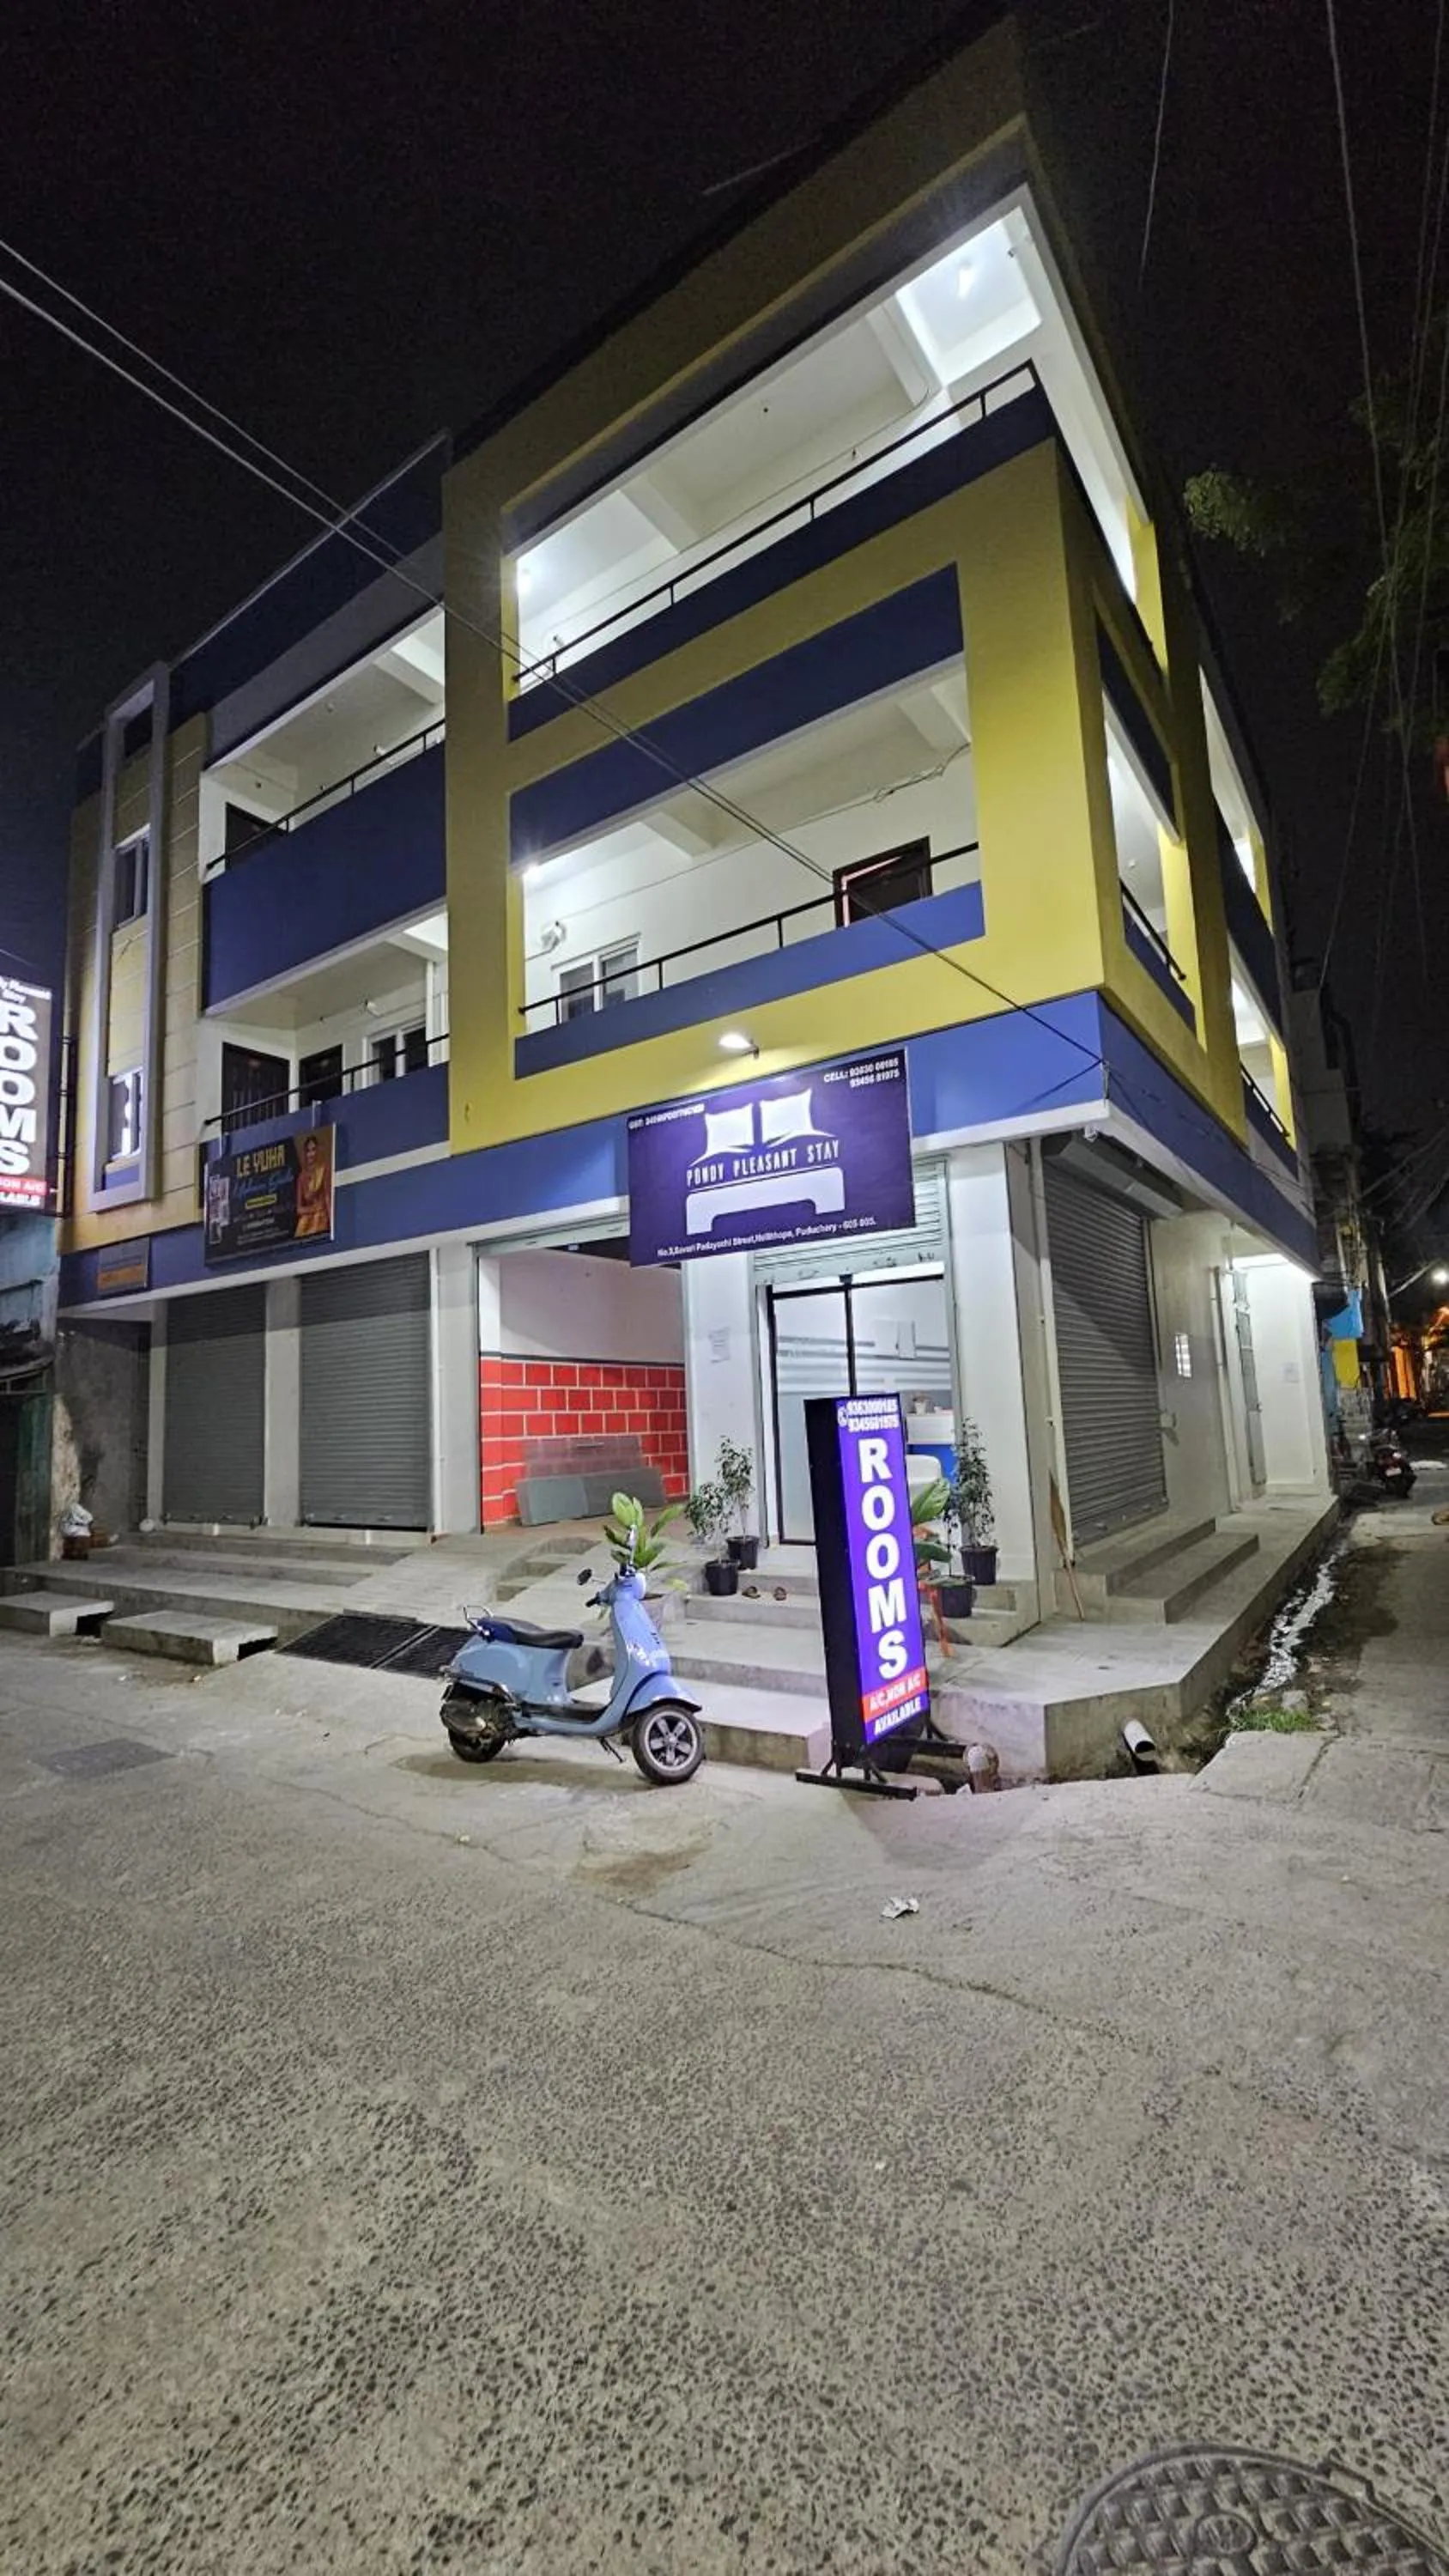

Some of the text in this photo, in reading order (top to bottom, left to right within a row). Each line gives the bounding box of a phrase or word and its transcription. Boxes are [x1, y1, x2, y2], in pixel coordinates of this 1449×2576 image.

[687, 1139, 840, 1188] PONDY PLEASANT STAY
[858, 1438, 908, 1679] ROOMS
[874, 1696, 921, 1735] AVAILABLE
